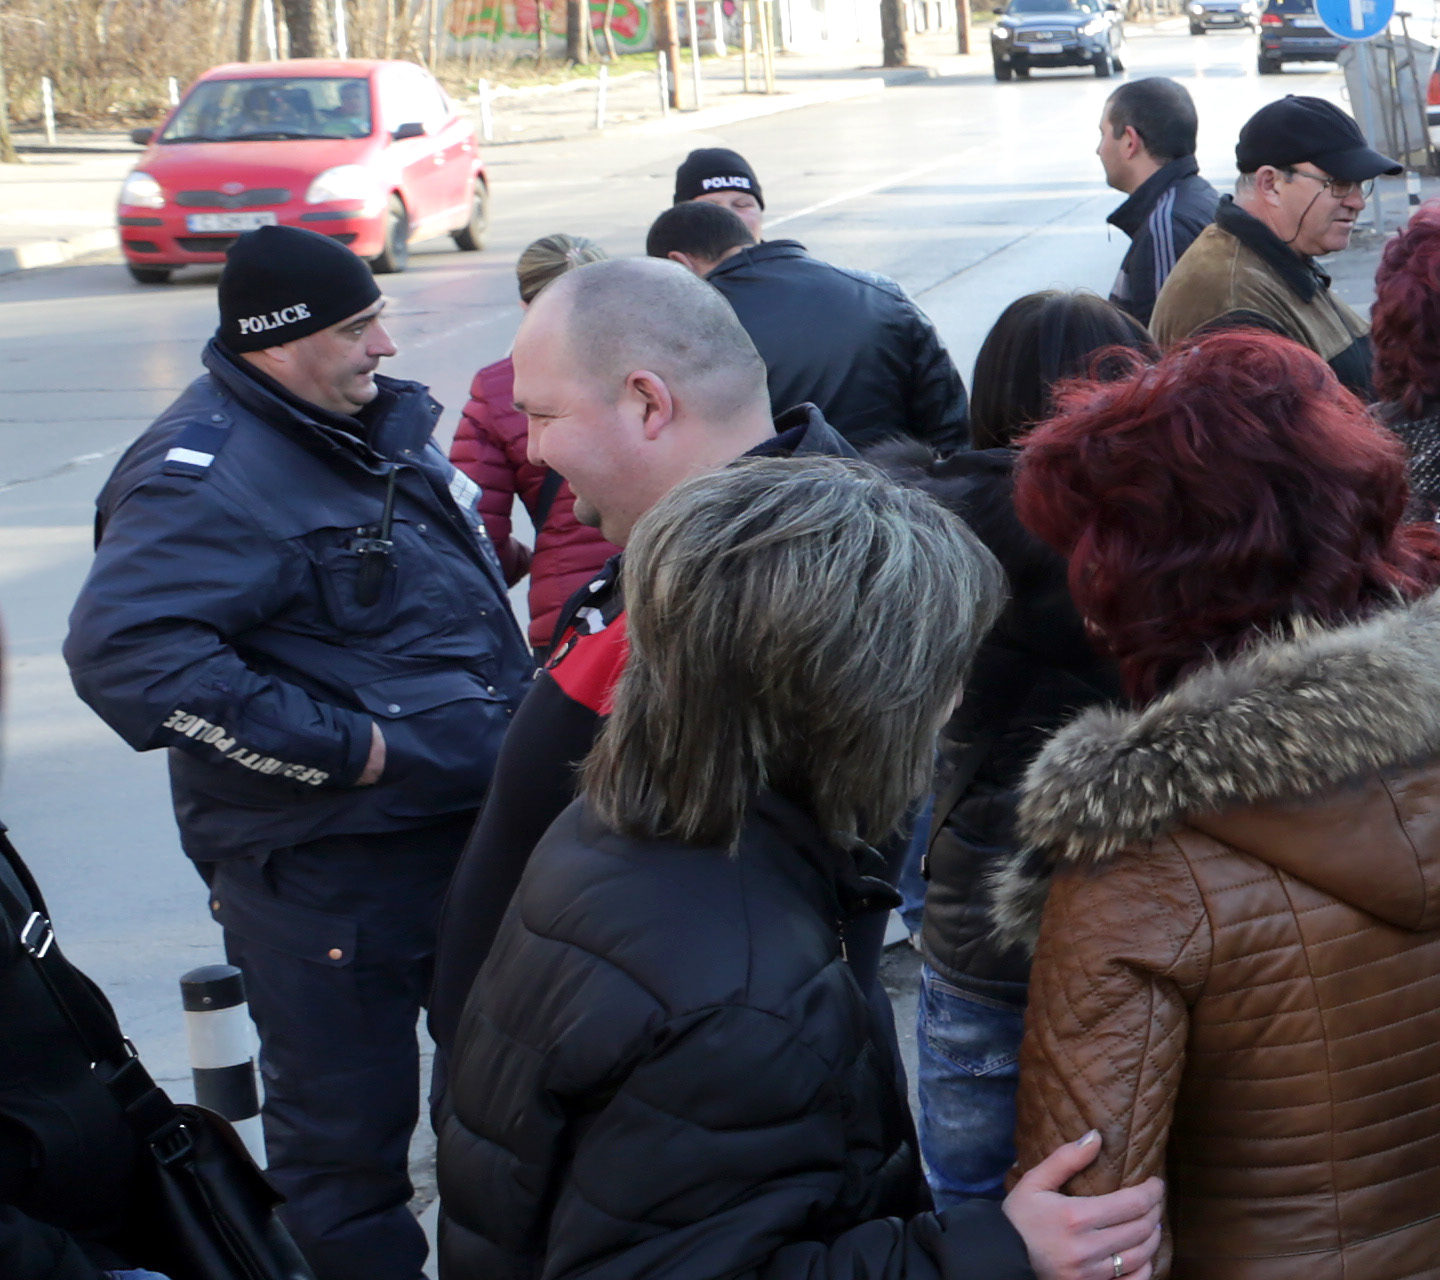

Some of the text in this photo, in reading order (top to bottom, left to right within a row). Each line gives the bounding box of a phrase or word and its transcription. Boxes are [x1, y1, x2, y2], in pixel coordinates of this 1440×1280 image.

[702, 176, 751, 191] POLICE
[237, 302, 312, 335] POLICE
[162, 709, 236, 752] POLICE
